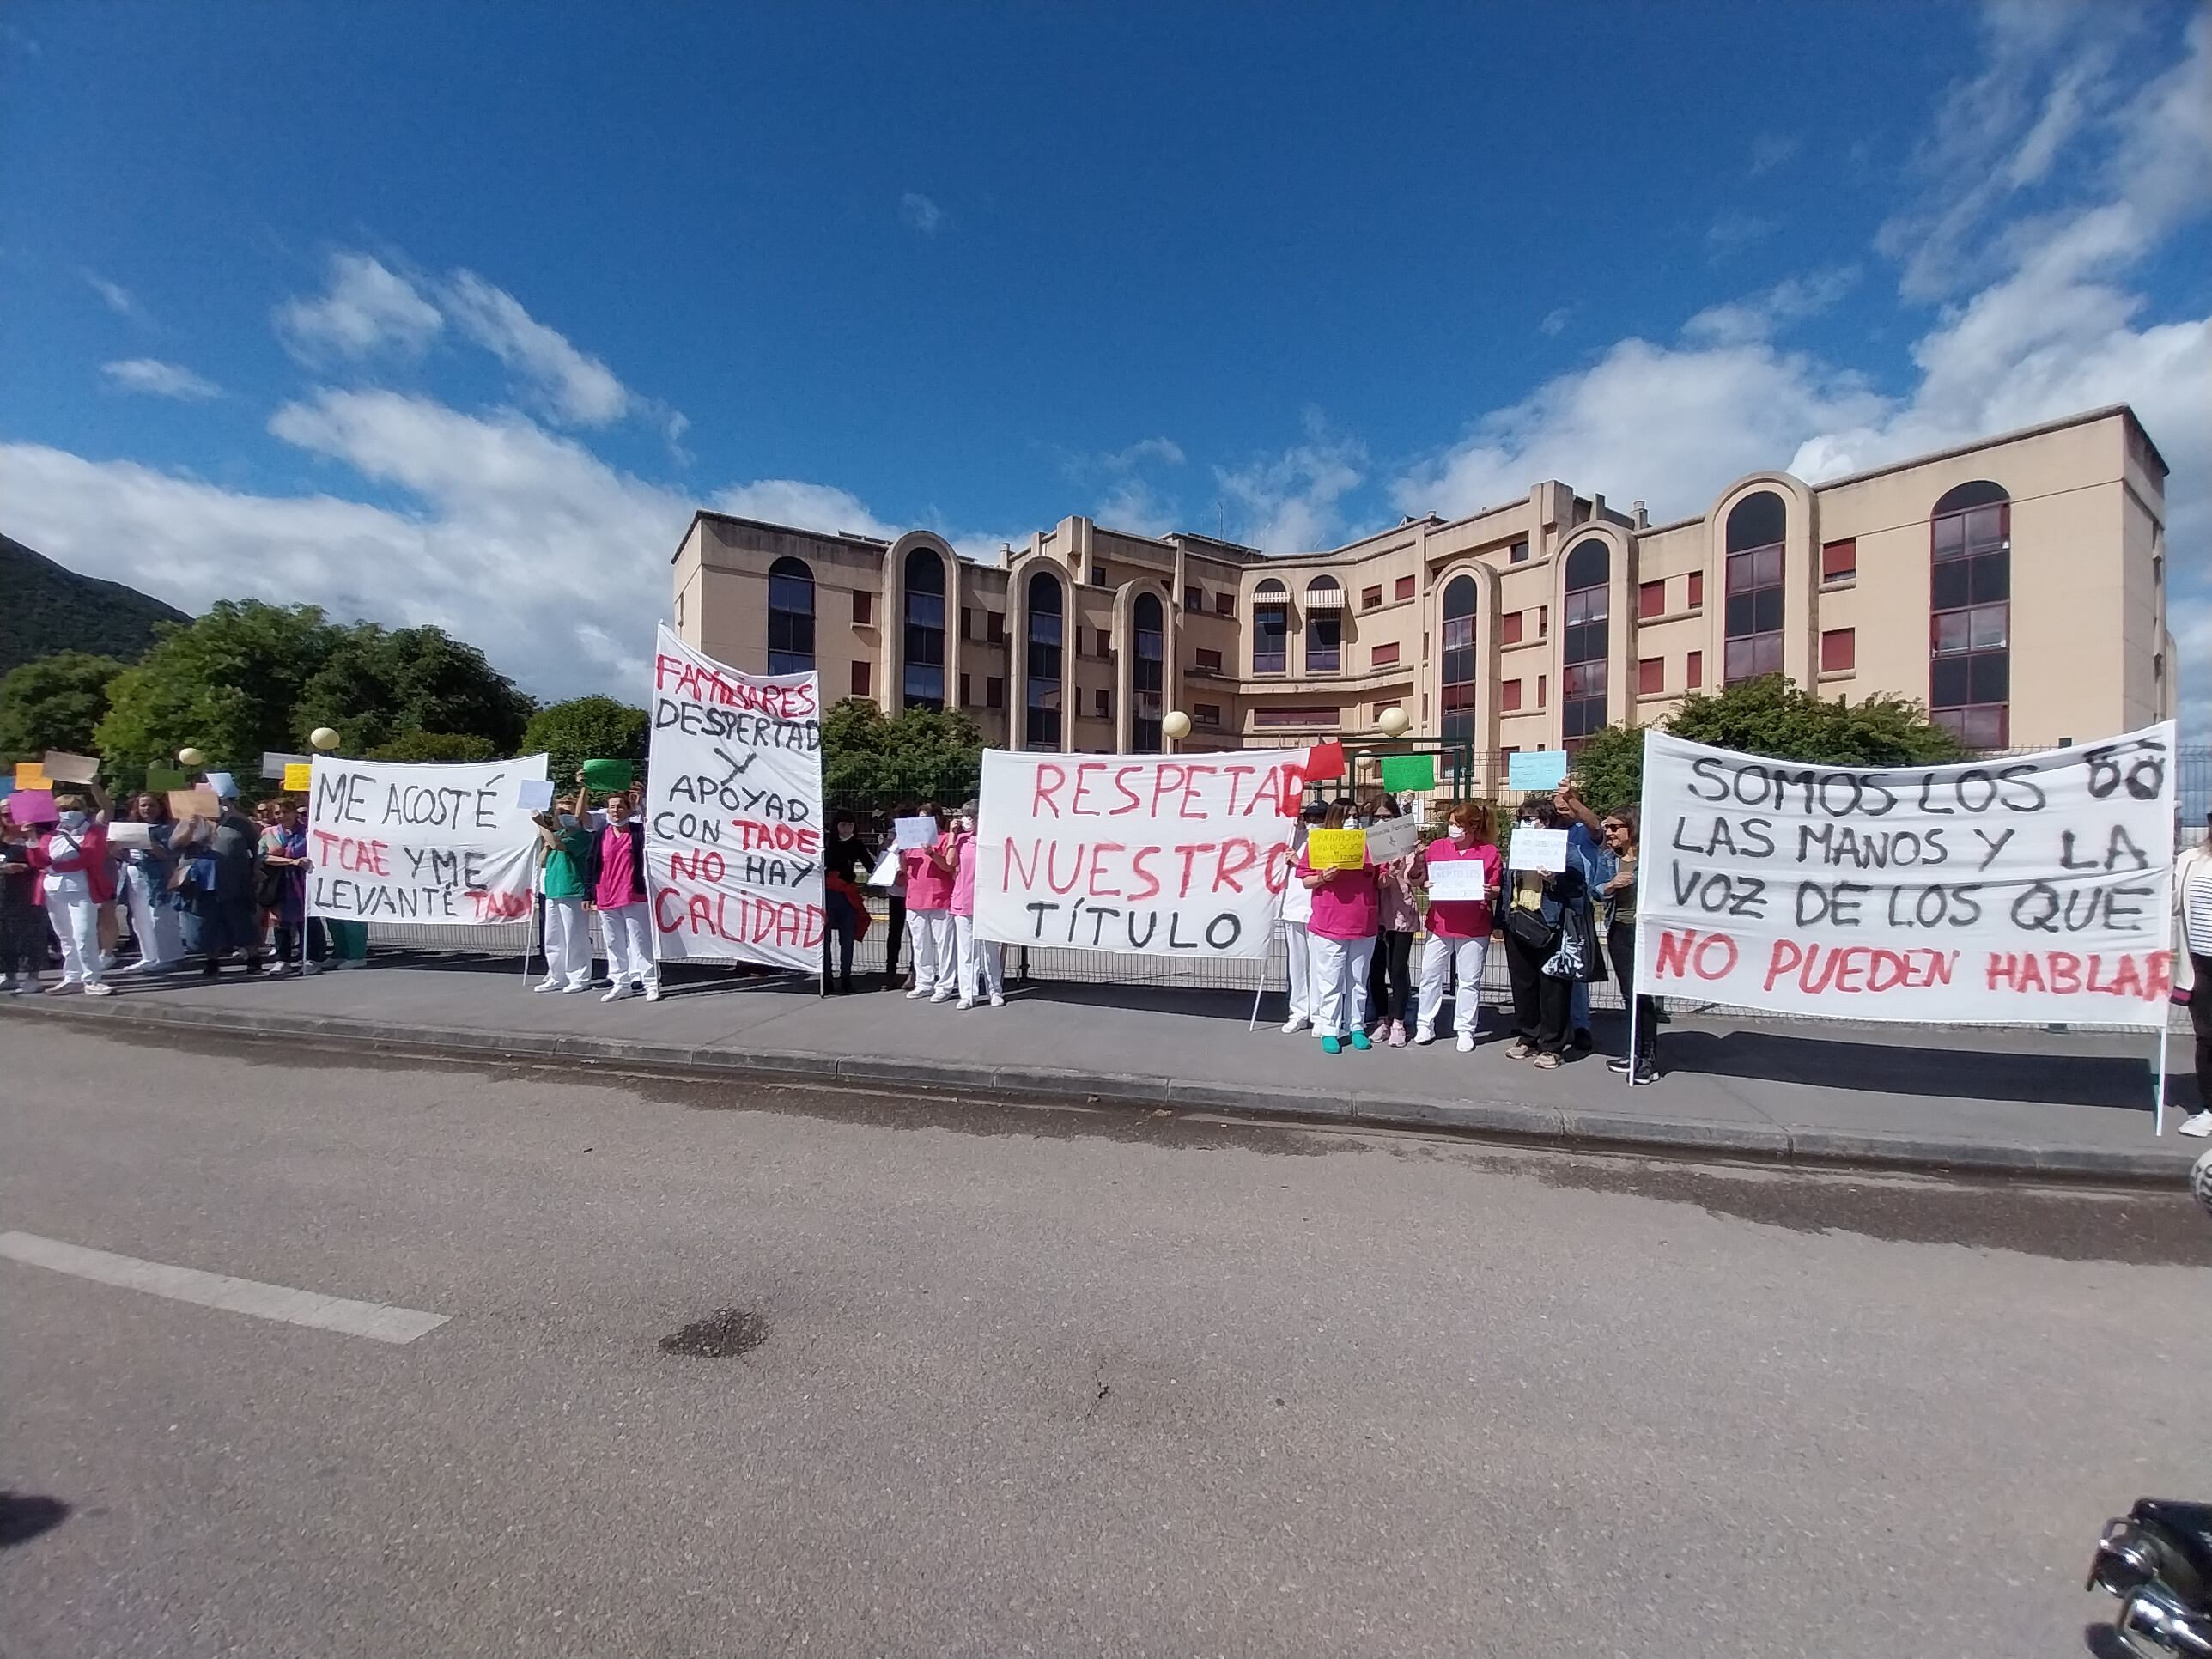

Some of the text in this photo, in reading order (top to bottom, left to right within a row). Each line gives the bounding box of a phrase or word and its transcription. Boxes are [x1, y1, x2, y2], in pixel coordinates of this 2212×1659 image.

[655, 698, 821, 752] DESPERTAD
[714, 747, 757, 787] Y
[1032, 762, 1307, 819] RESPETAD
[1687, 757, 2047, 817] SOMOS LOS
[314, 773, 376, 823] ME
[381, 774, 506, 830] ACOSTÉ
[668, 775, 810, 823] APOYAD
[313, 830, 488, 890] TCAE Y ME
[653, 811, 821, 854] CON TADE
[1671, 816, 2150, 873] LAS MANOS Y LA
[670, 847, 816, 888] NO HAY
[1002, 836, 1291, 902] NUESTRO
[654, 887, 828, 949] CALIDAD
[1025, 897, 1242, 950] TÍTULO
[1671, 860, 2156, 933] VOZ DE LOS QUE
[1654, 928, 2172, 1003] NO PUEDEN HABLAR
